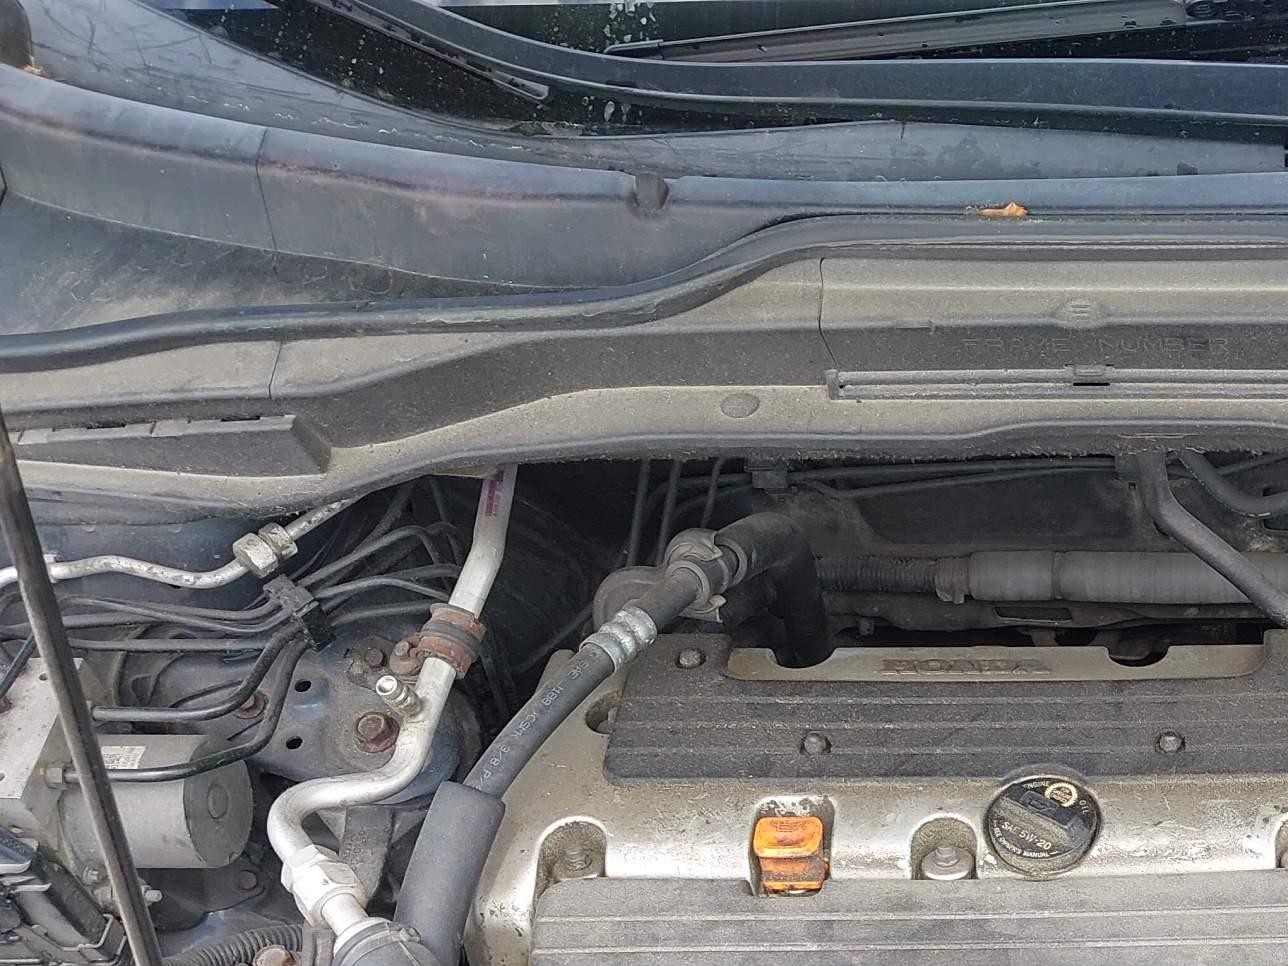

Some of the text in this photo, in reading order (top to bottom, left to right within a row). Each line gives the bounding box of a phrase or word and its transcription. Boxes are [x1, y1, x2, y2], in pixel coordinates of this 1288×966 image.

[880, 658, 1053, 676] HONDA
[1079, 799, 1089, 814] OIL
[1001, 821, 1052, 850] SAE 5W-20
[1022, 850, 1051, 858] MANUAL
